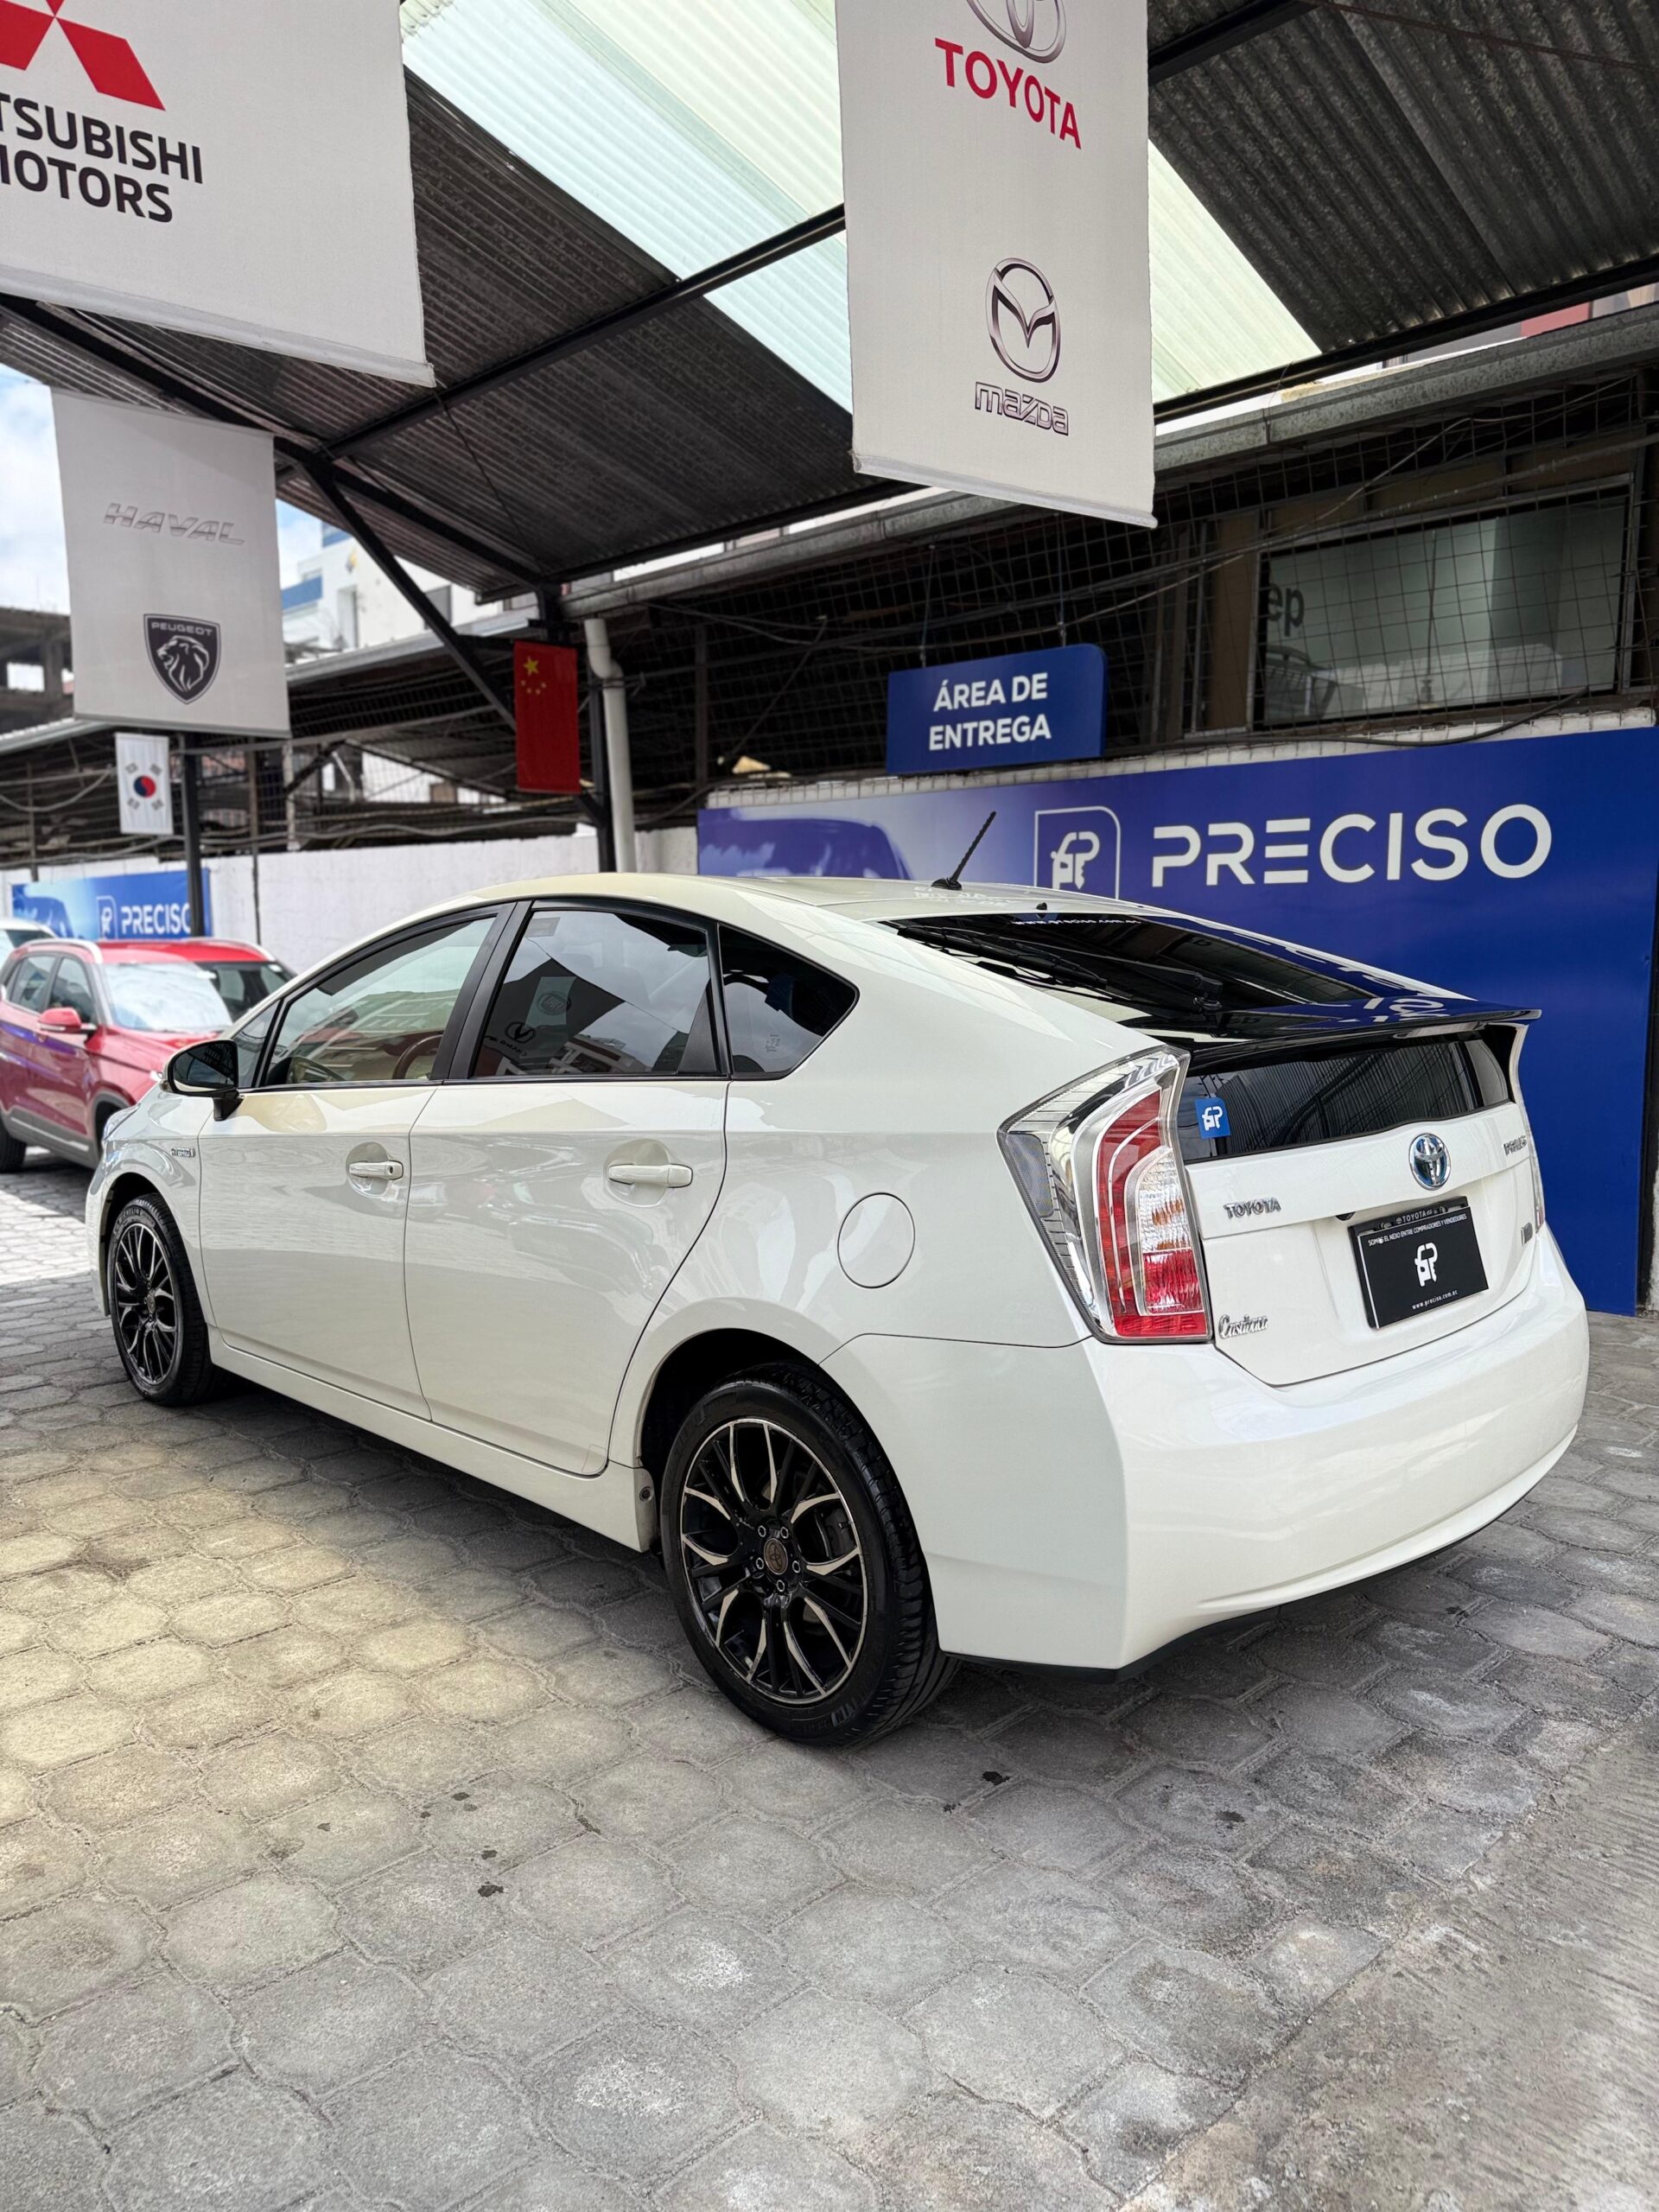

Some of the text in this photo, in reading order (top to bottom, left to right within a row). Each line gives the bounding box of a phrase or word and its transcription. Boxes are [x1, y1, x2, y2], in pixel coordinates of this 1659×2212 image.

[935, 37, 1082, 149] TOYOTA
[104, 502, 245, 545] HAVAL
[150, 621, 213, 637] PEUGEOT
[933, 672, 1048, 712] ÁREA DE
[929, 714, 1052, 751] ENTREGA
[1152, 804, 1552, 887] PRECISO
[1224, 1197, 1281, 1219] TOYOTA
[1402, 1211, 1427, 1223] TOYOTA
[1401, 1229, 1414, 1238] ENTRE
[1414, 1222, 1441, 1233] COMPRADORES
[1444, 1213, 1467, 1224] VENDEDORES
[1412, 1290, 1458, 1310] www.preciso.com.ec
